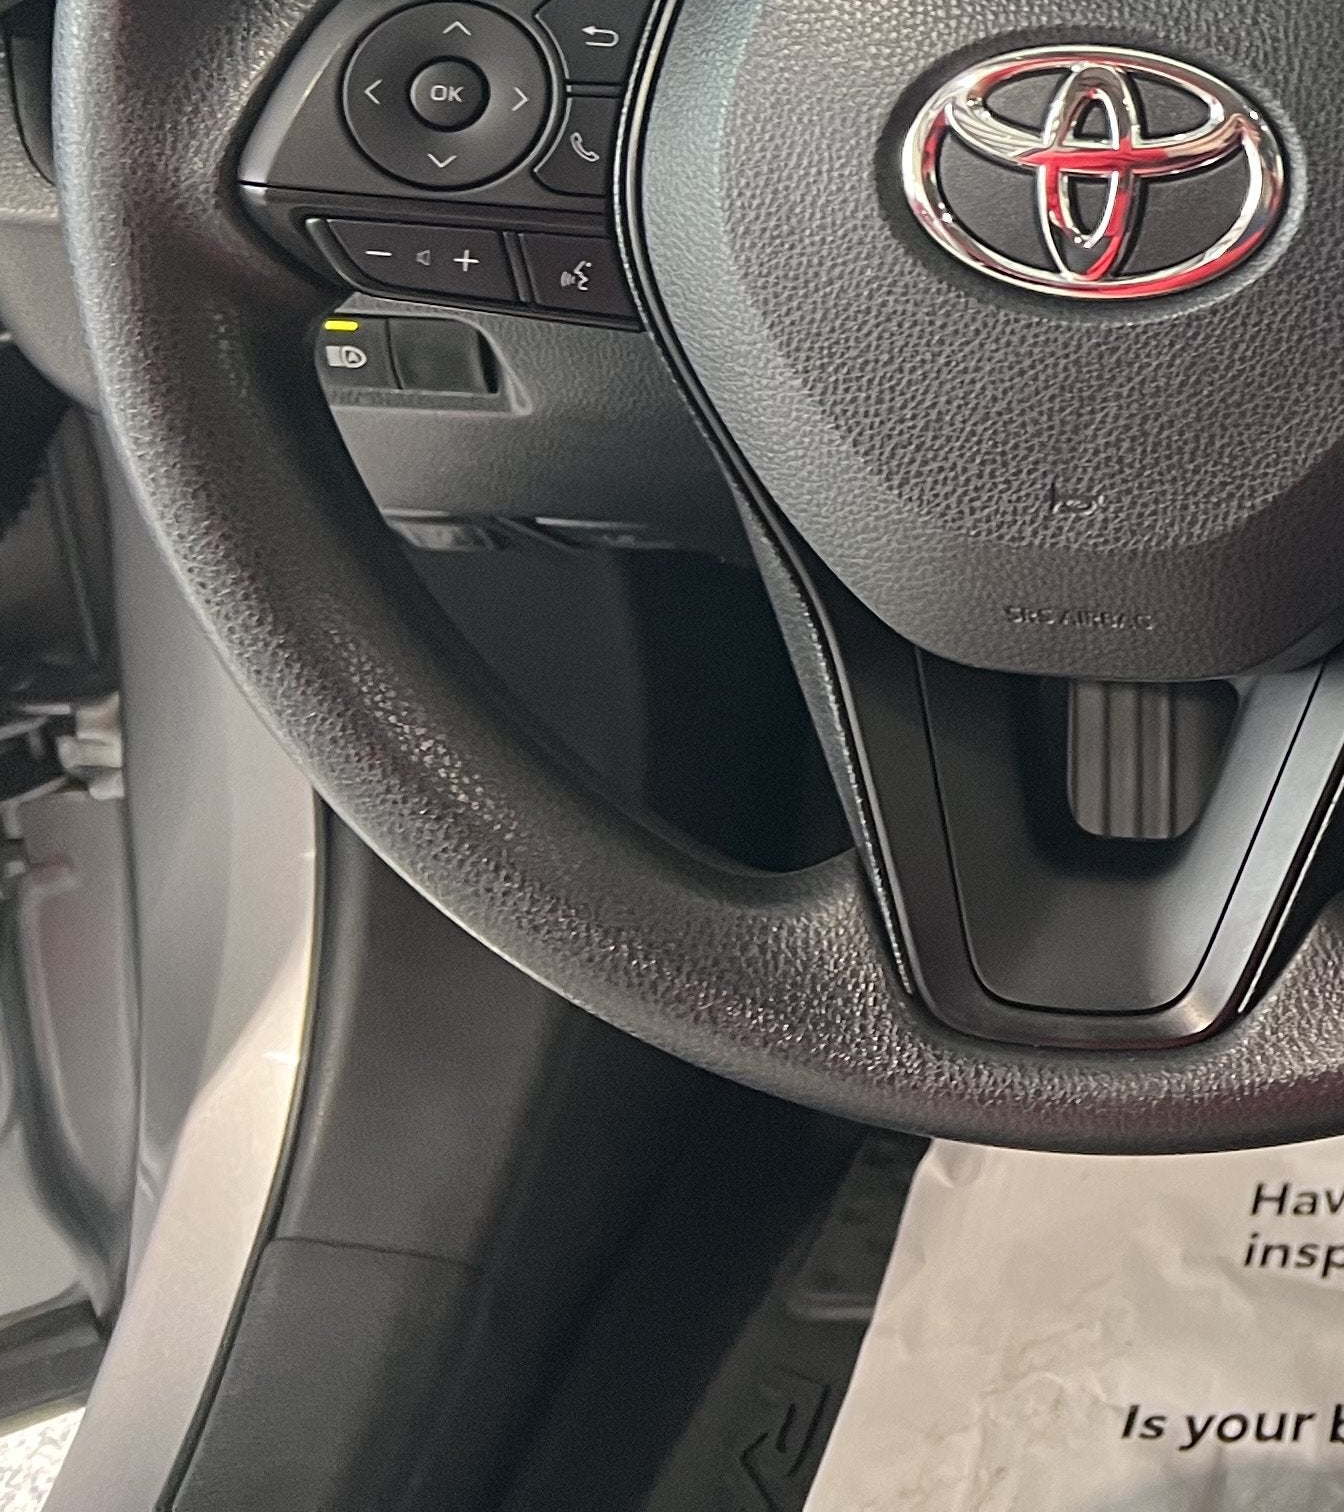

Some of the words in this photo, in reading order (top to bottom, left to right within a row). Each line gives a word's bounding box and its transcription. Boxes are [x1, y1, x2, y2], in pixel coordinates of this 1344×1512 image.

[430, 85, 464, 103] OK
[1120, 1403, 1166, 1441] Is
[1179, 1409, 1315, 1451] your
